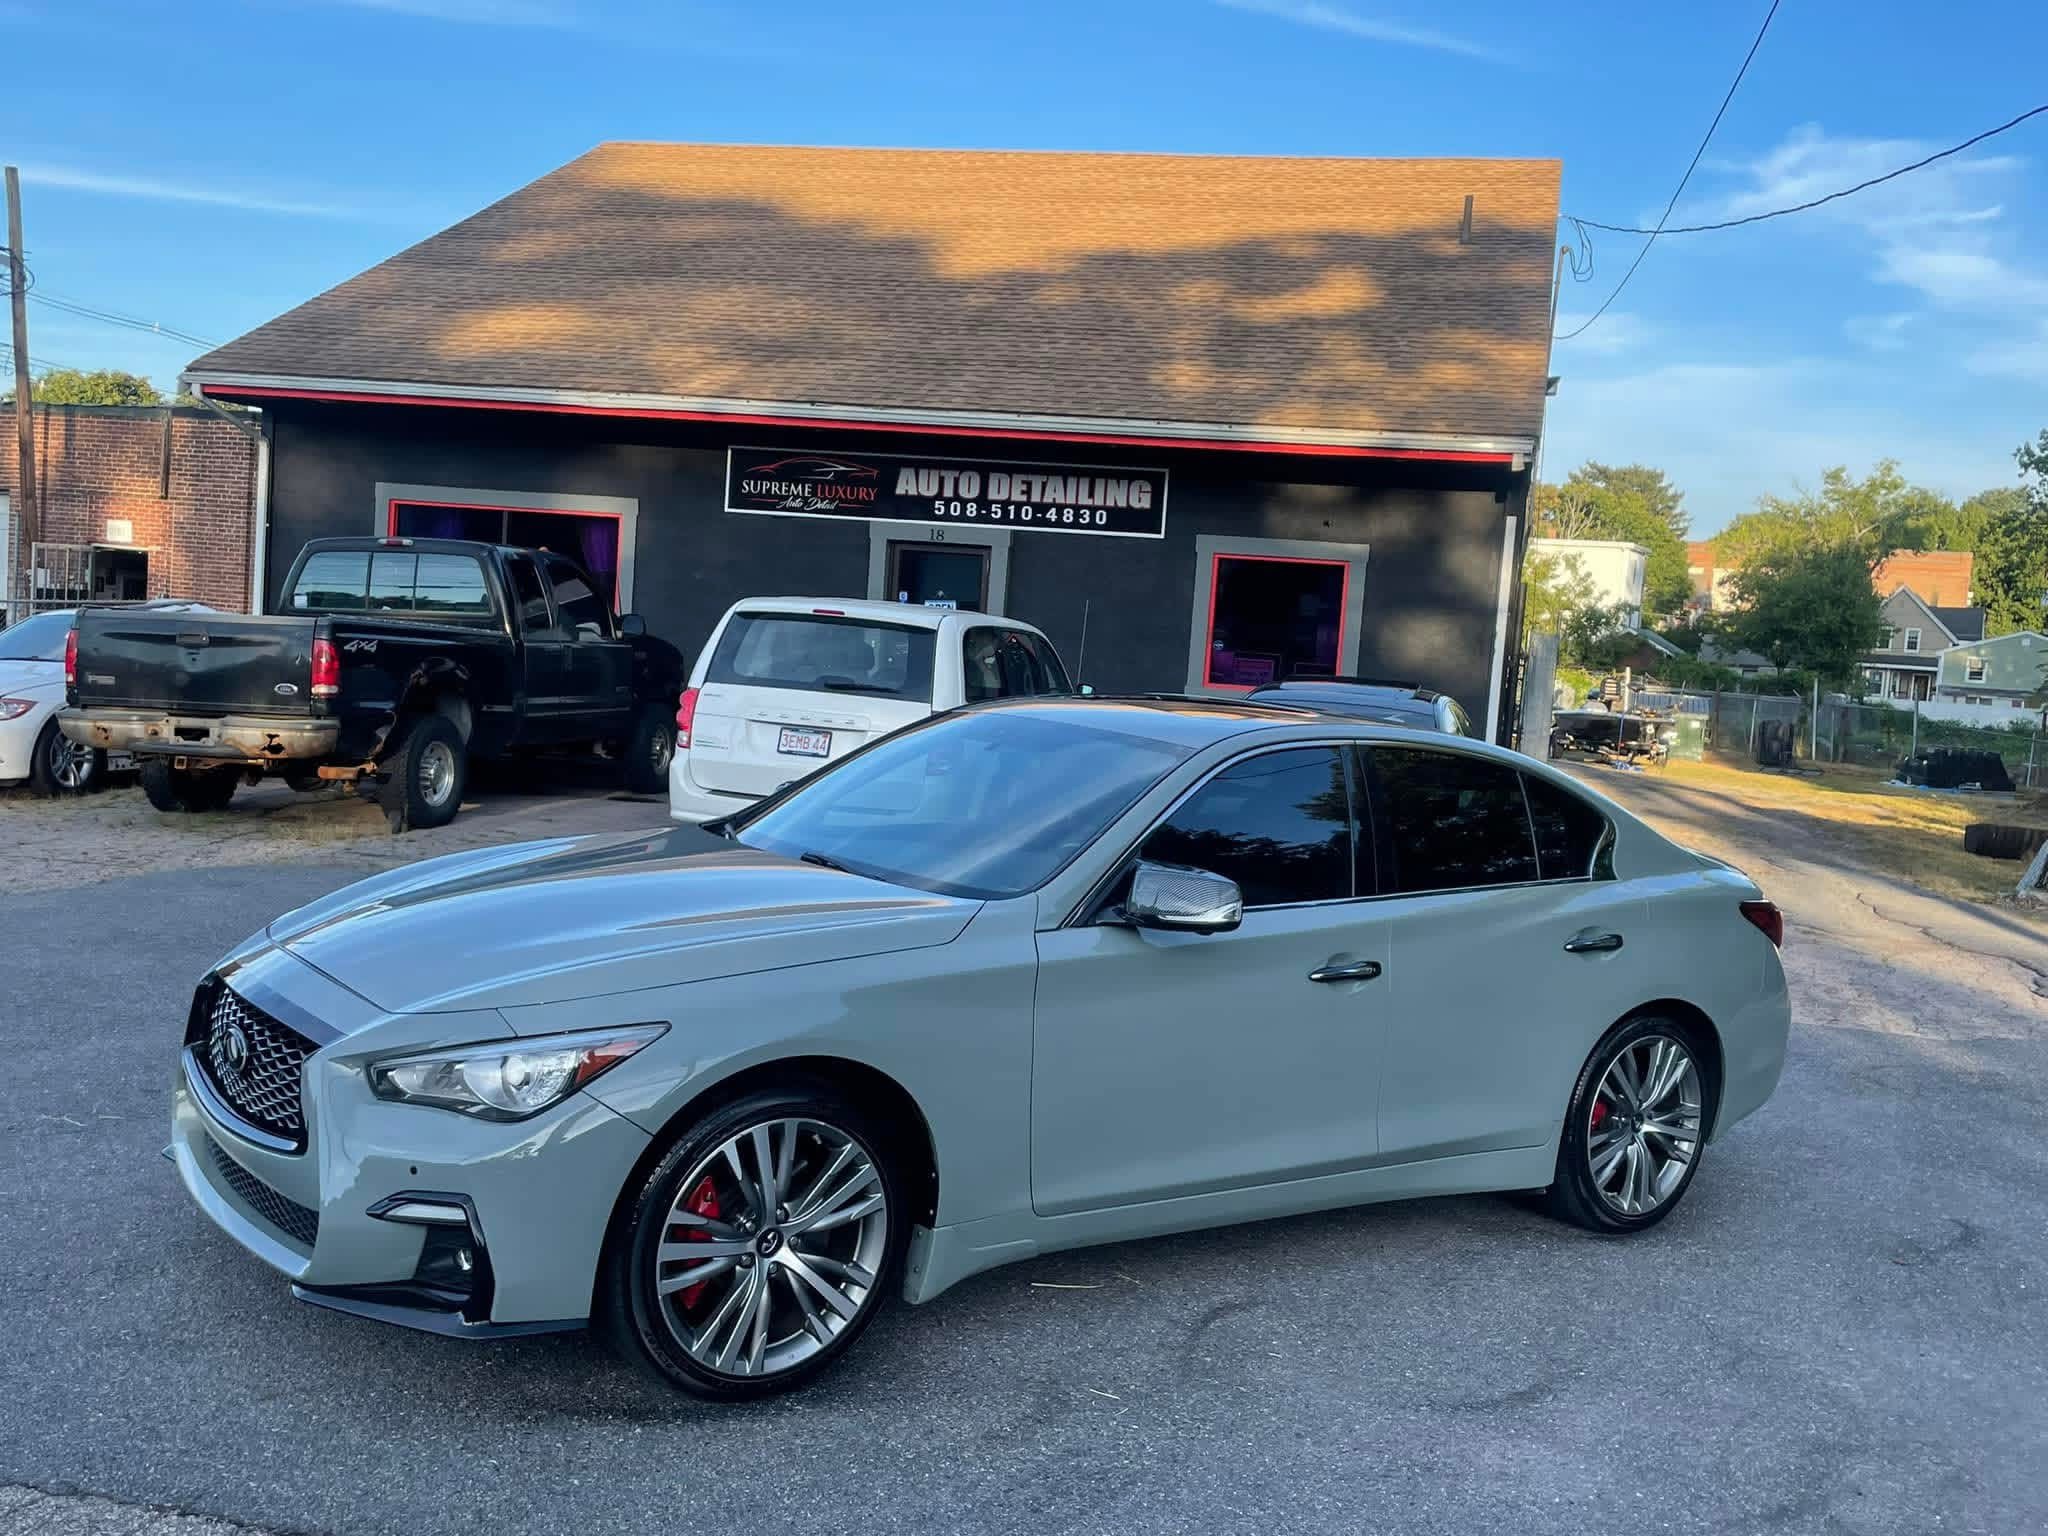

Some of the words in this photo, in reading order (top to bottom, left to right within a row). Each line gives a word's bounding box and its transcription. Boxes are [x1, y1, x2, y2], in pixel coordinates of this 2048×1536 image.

[741, 479, 813, 497] SUPREME
[816, 484, 879, 501] LUXURY
[895, 466, 981, 499] AUTO
[987, 472, 1153, 510] DETAILING
[933, 500, 1108, 526] 508-510-4830
[929, 527, 945, 542] 18
